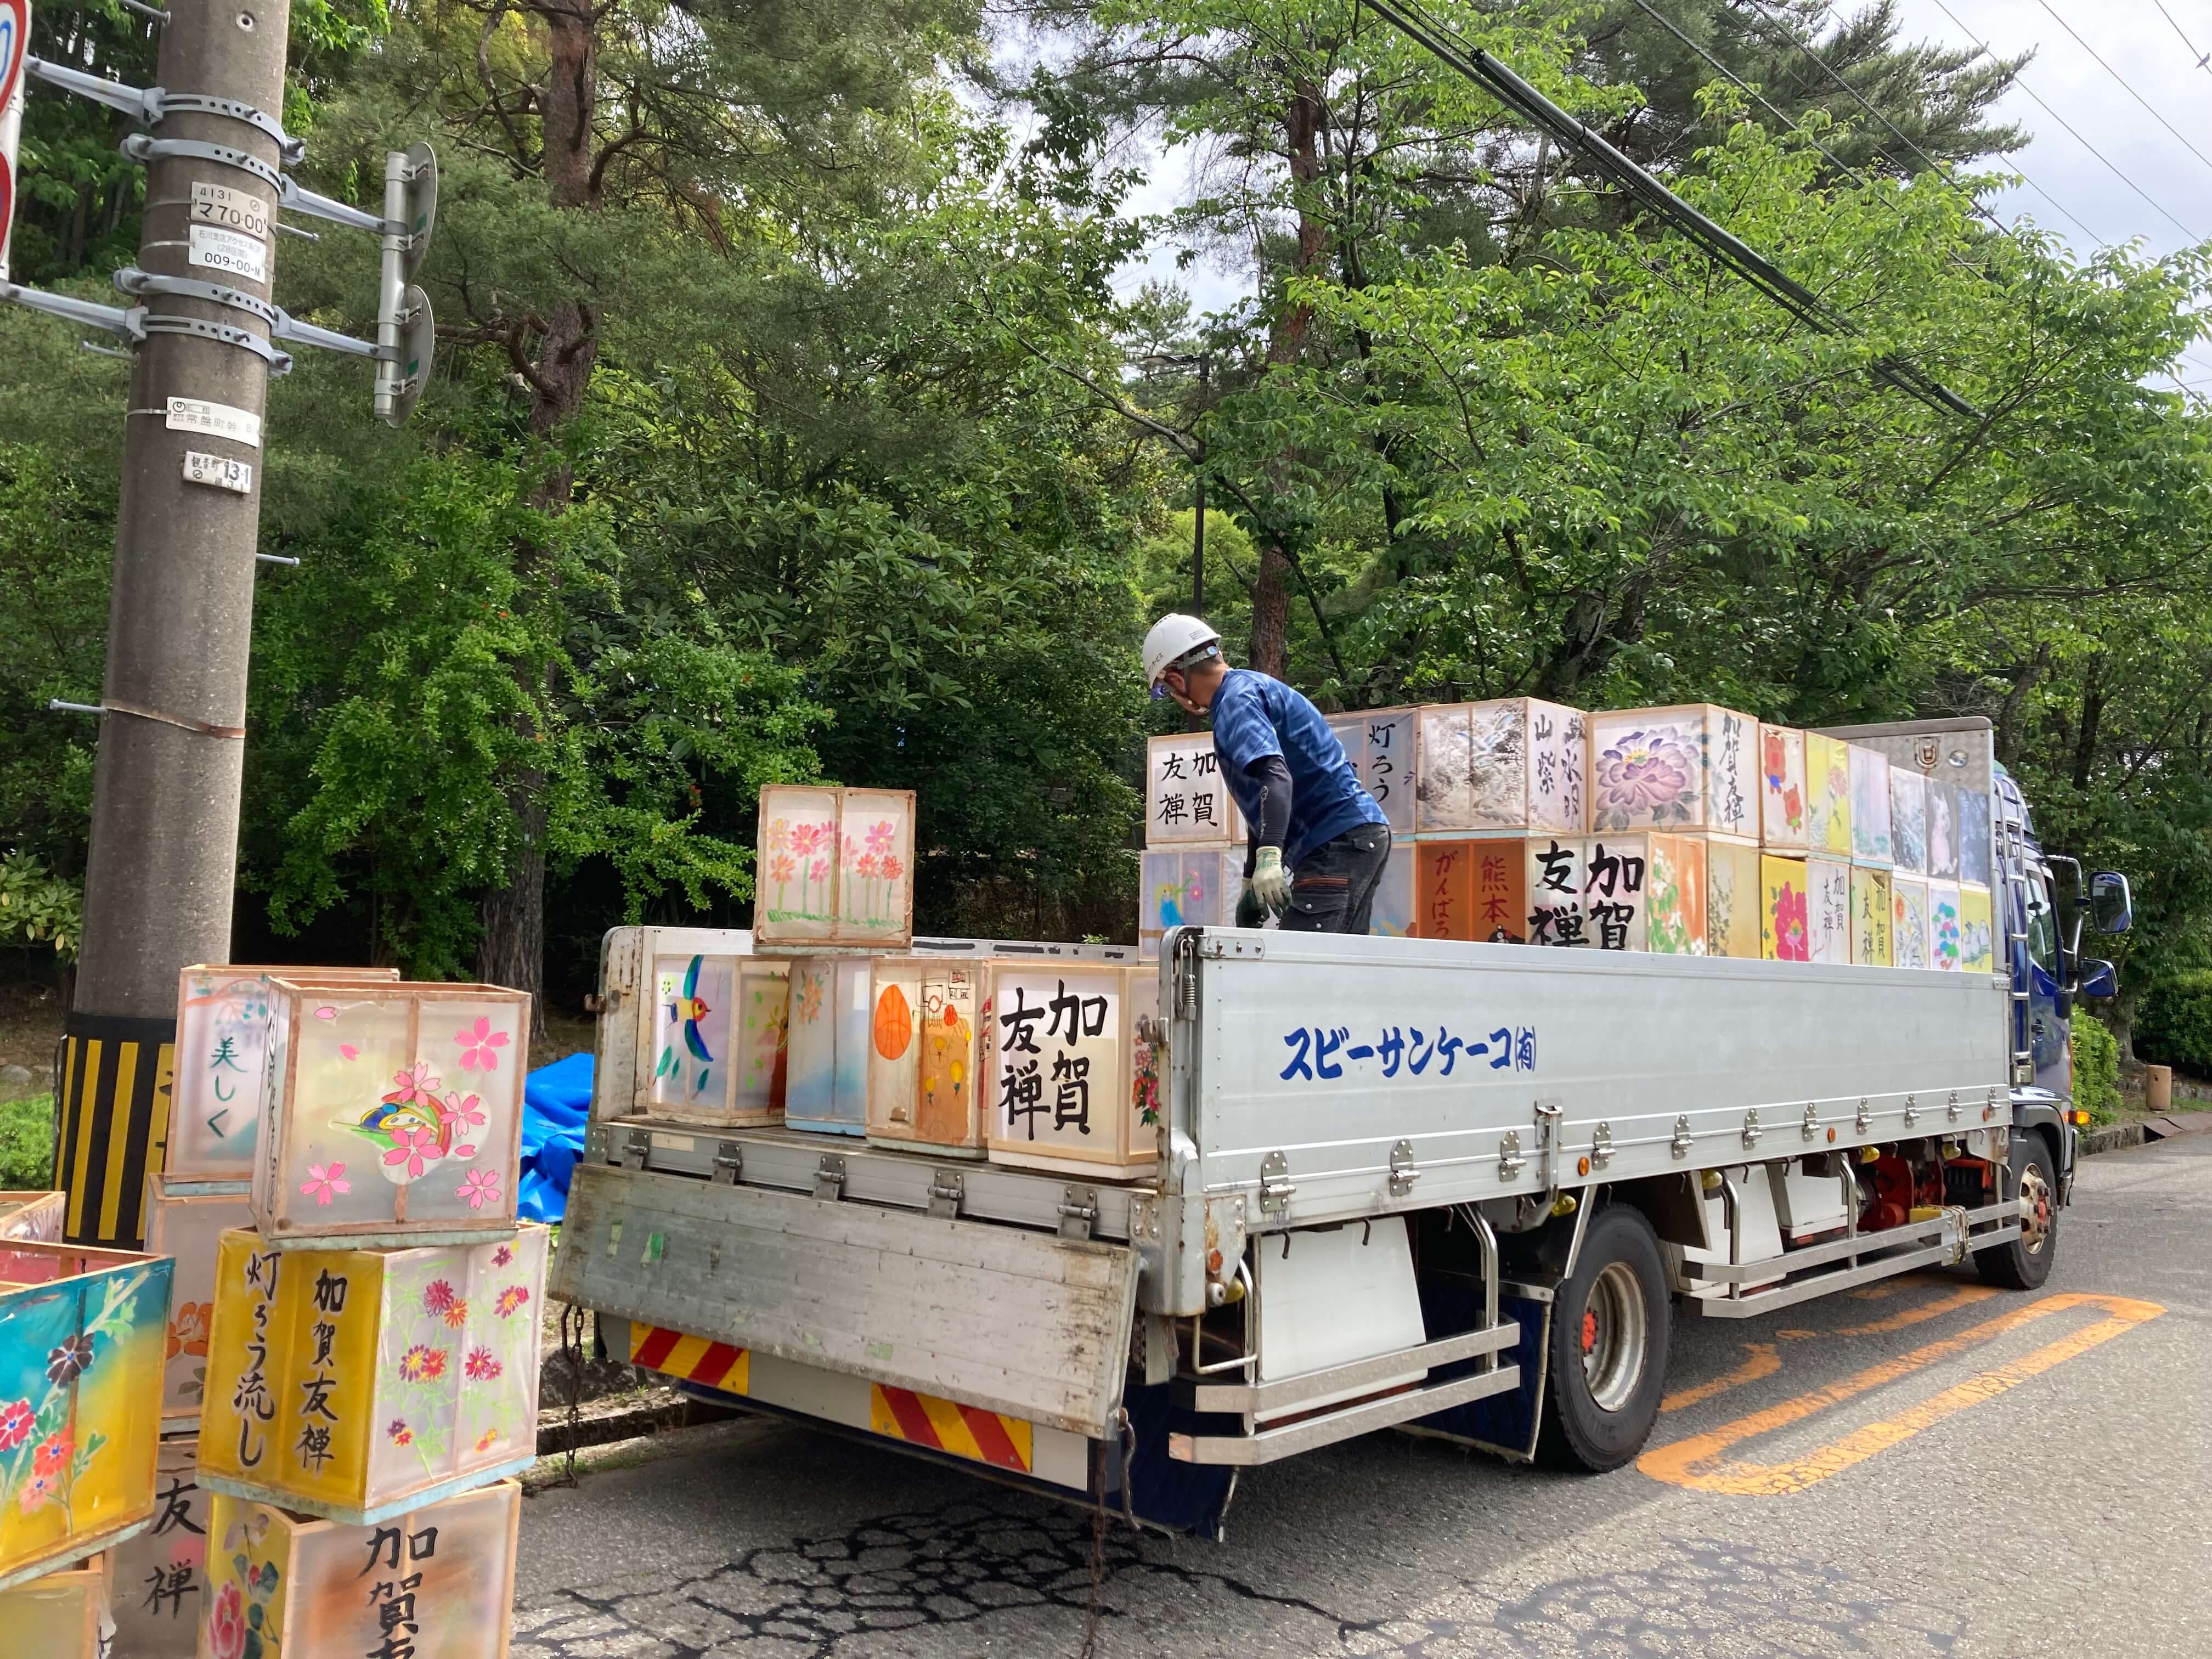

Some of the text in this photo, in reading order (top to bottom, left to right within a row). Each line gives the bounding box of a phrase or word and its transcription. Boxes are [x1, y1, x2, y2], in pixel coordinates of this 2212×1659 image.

[200, 187, 230, 201] 4131
[205, 252, 260, 278] 009-00-M
[1481, 855, 1510, 923] 熊本
[207, 1036, 248, 1138] 美しく
[294, 1268, 347, 1474] 加賀友禅
